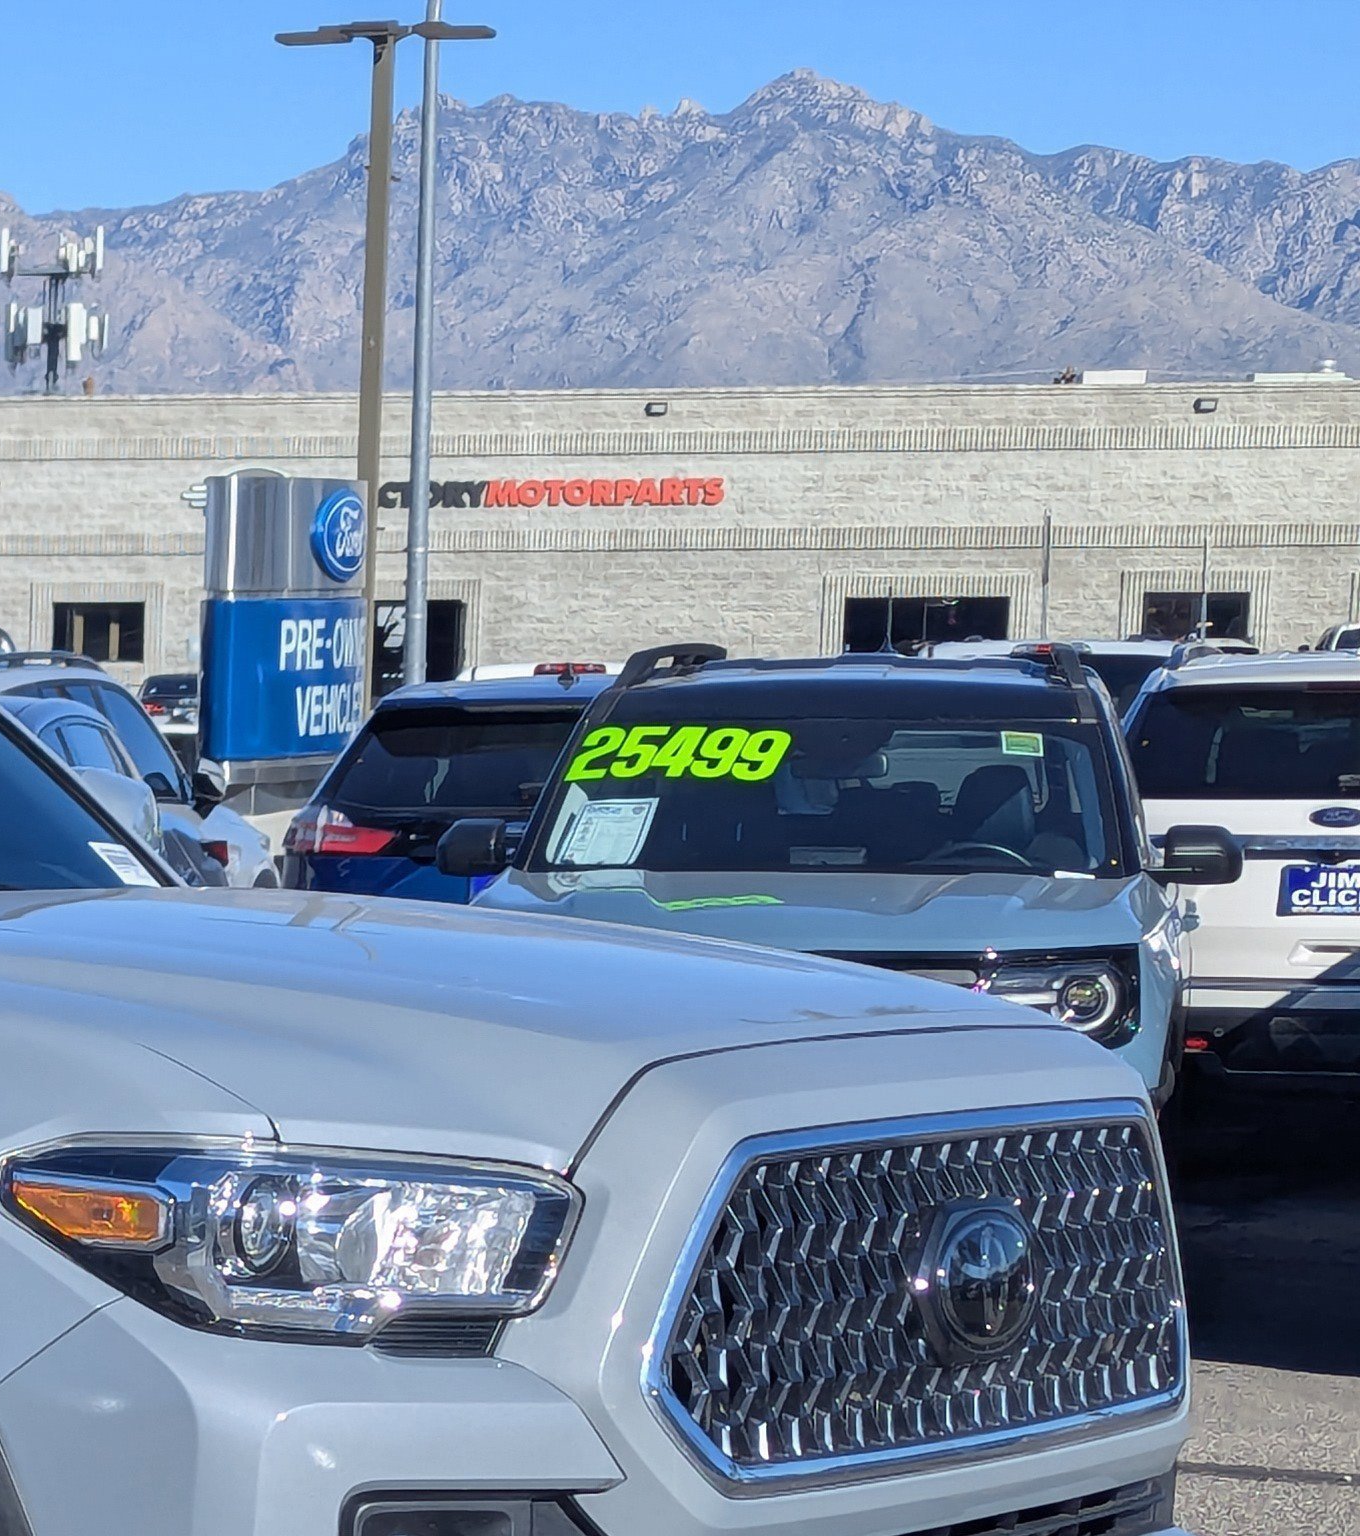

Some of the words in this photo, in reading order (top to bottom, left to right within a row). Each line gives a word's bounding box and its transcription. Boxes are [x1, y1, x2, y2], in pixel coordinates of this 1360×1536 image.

[563, 725, 792, 783] 25499
[1310, 872, 1360, 889] JIM
[1291, 889, 1360, 906] CLIC
